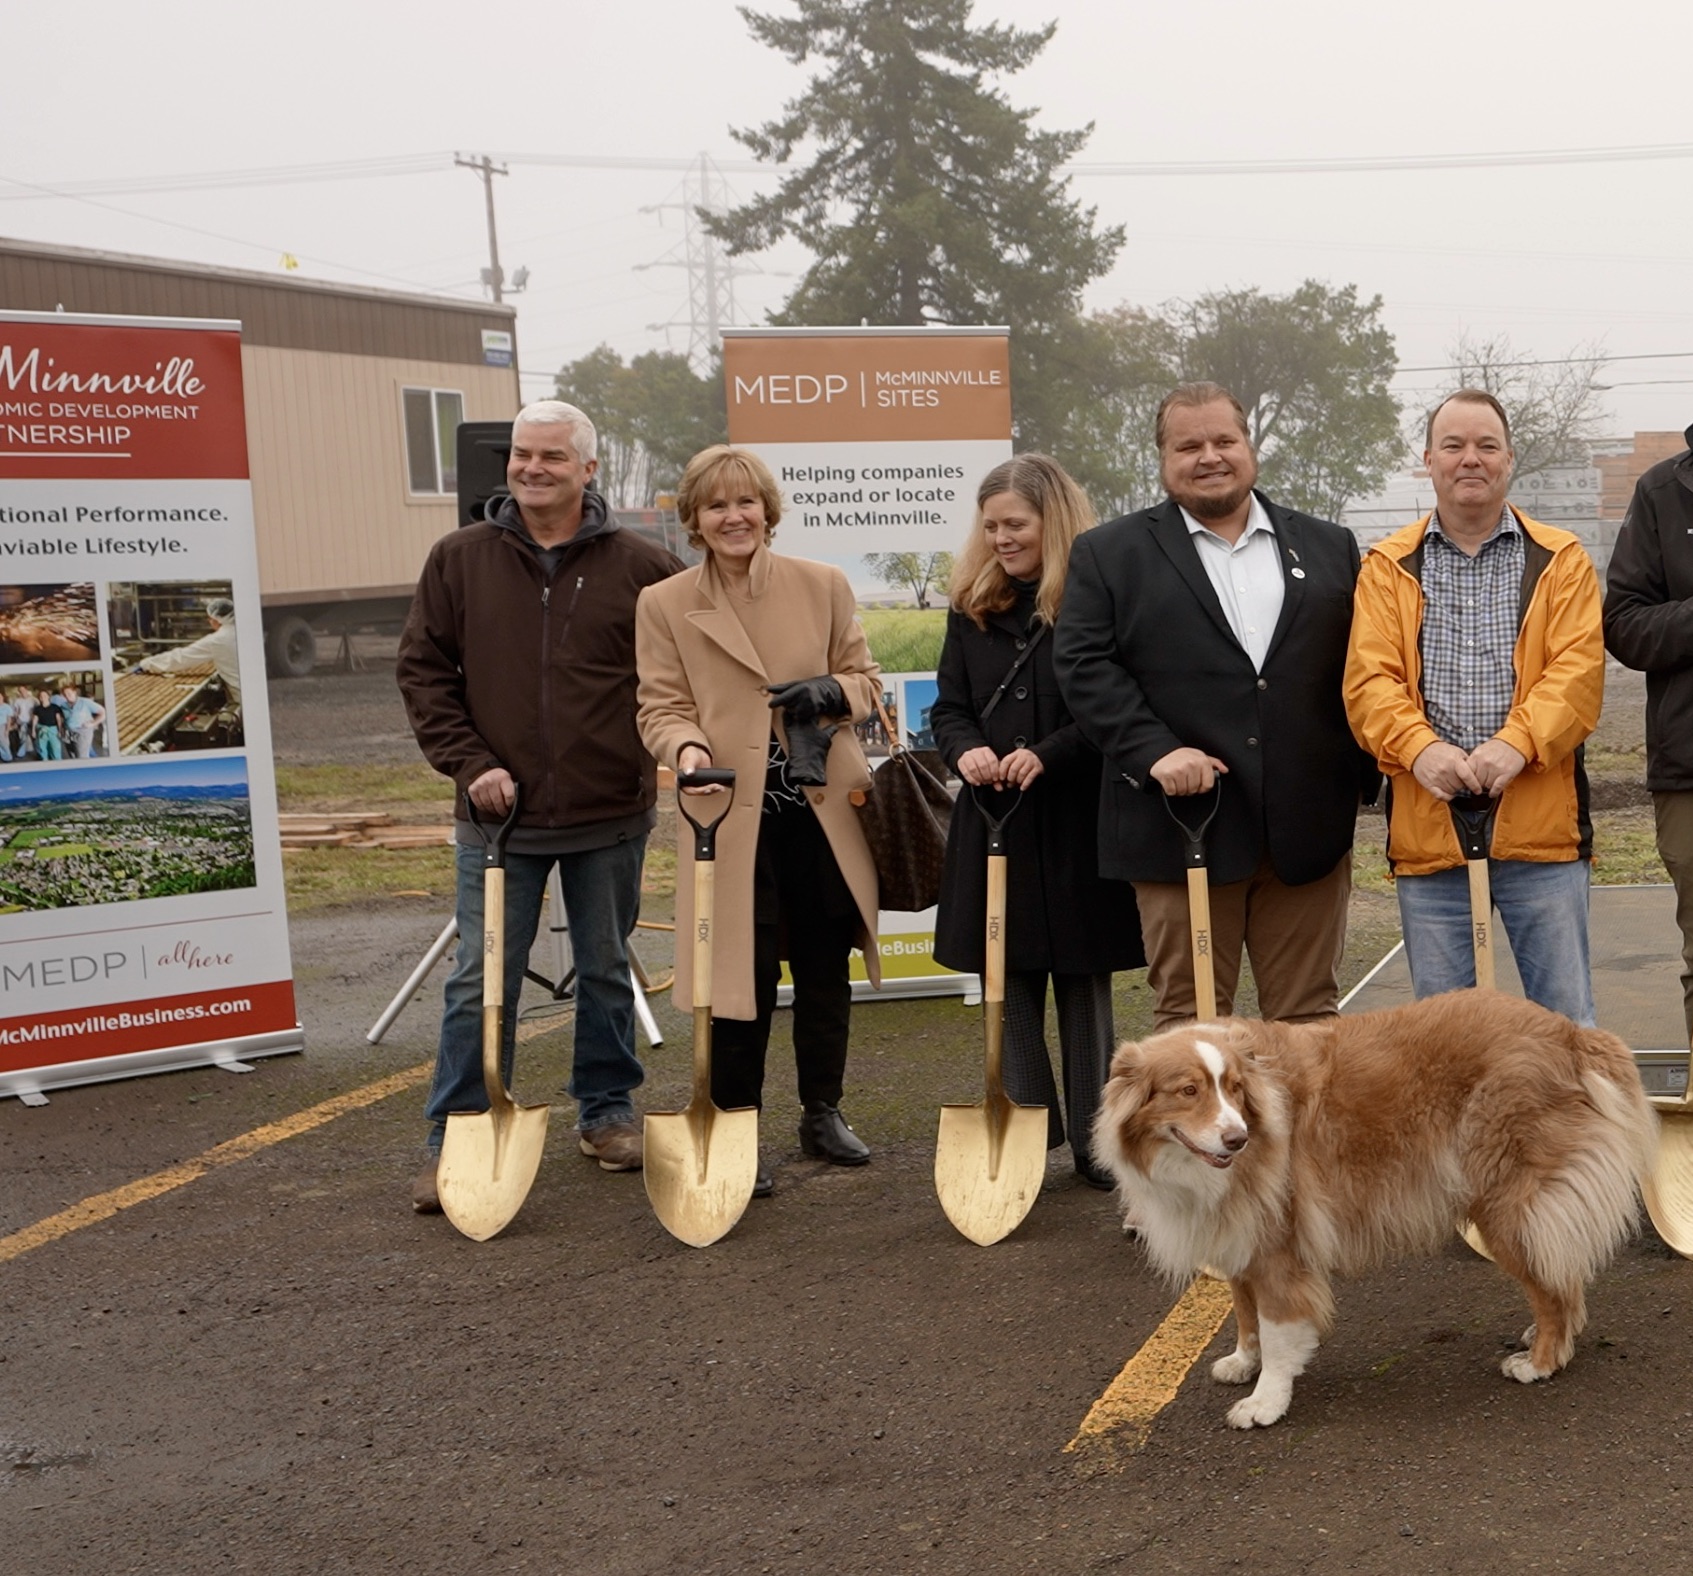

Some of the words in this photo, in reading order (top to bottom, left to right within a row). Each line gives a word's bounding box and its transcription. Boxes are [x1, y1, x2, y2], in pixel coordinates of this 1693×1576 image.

[734, 374, 848, 404] MEDP
[876, 370, 1001, 385] McMINNVILLE
[877, 389, 940, 407] SITES
[50, 403, 199, 419] DEVELOPMENT
[781, 466, 856, 483] Helping
[861, 464, 964, 482] companies
[793, 487, 863, 506] expand
[869, 490, 890, 503] or
[896, 487, 955, 503] locate
[76, 507, 229, 523] Performance.
[804, 512, 820, 527] in
[827, 510, 947, 527] McMinnville.
[85, 537, 188, 556] Lifestyle.
[698, 918, 708, 943] HDX
[989, 916, 999, 941] HDX
[1476, 922, 1486, 949] HDX
[1197, 930, 1208, 956] HDX
[3, 952, 127, 991] MEDP
